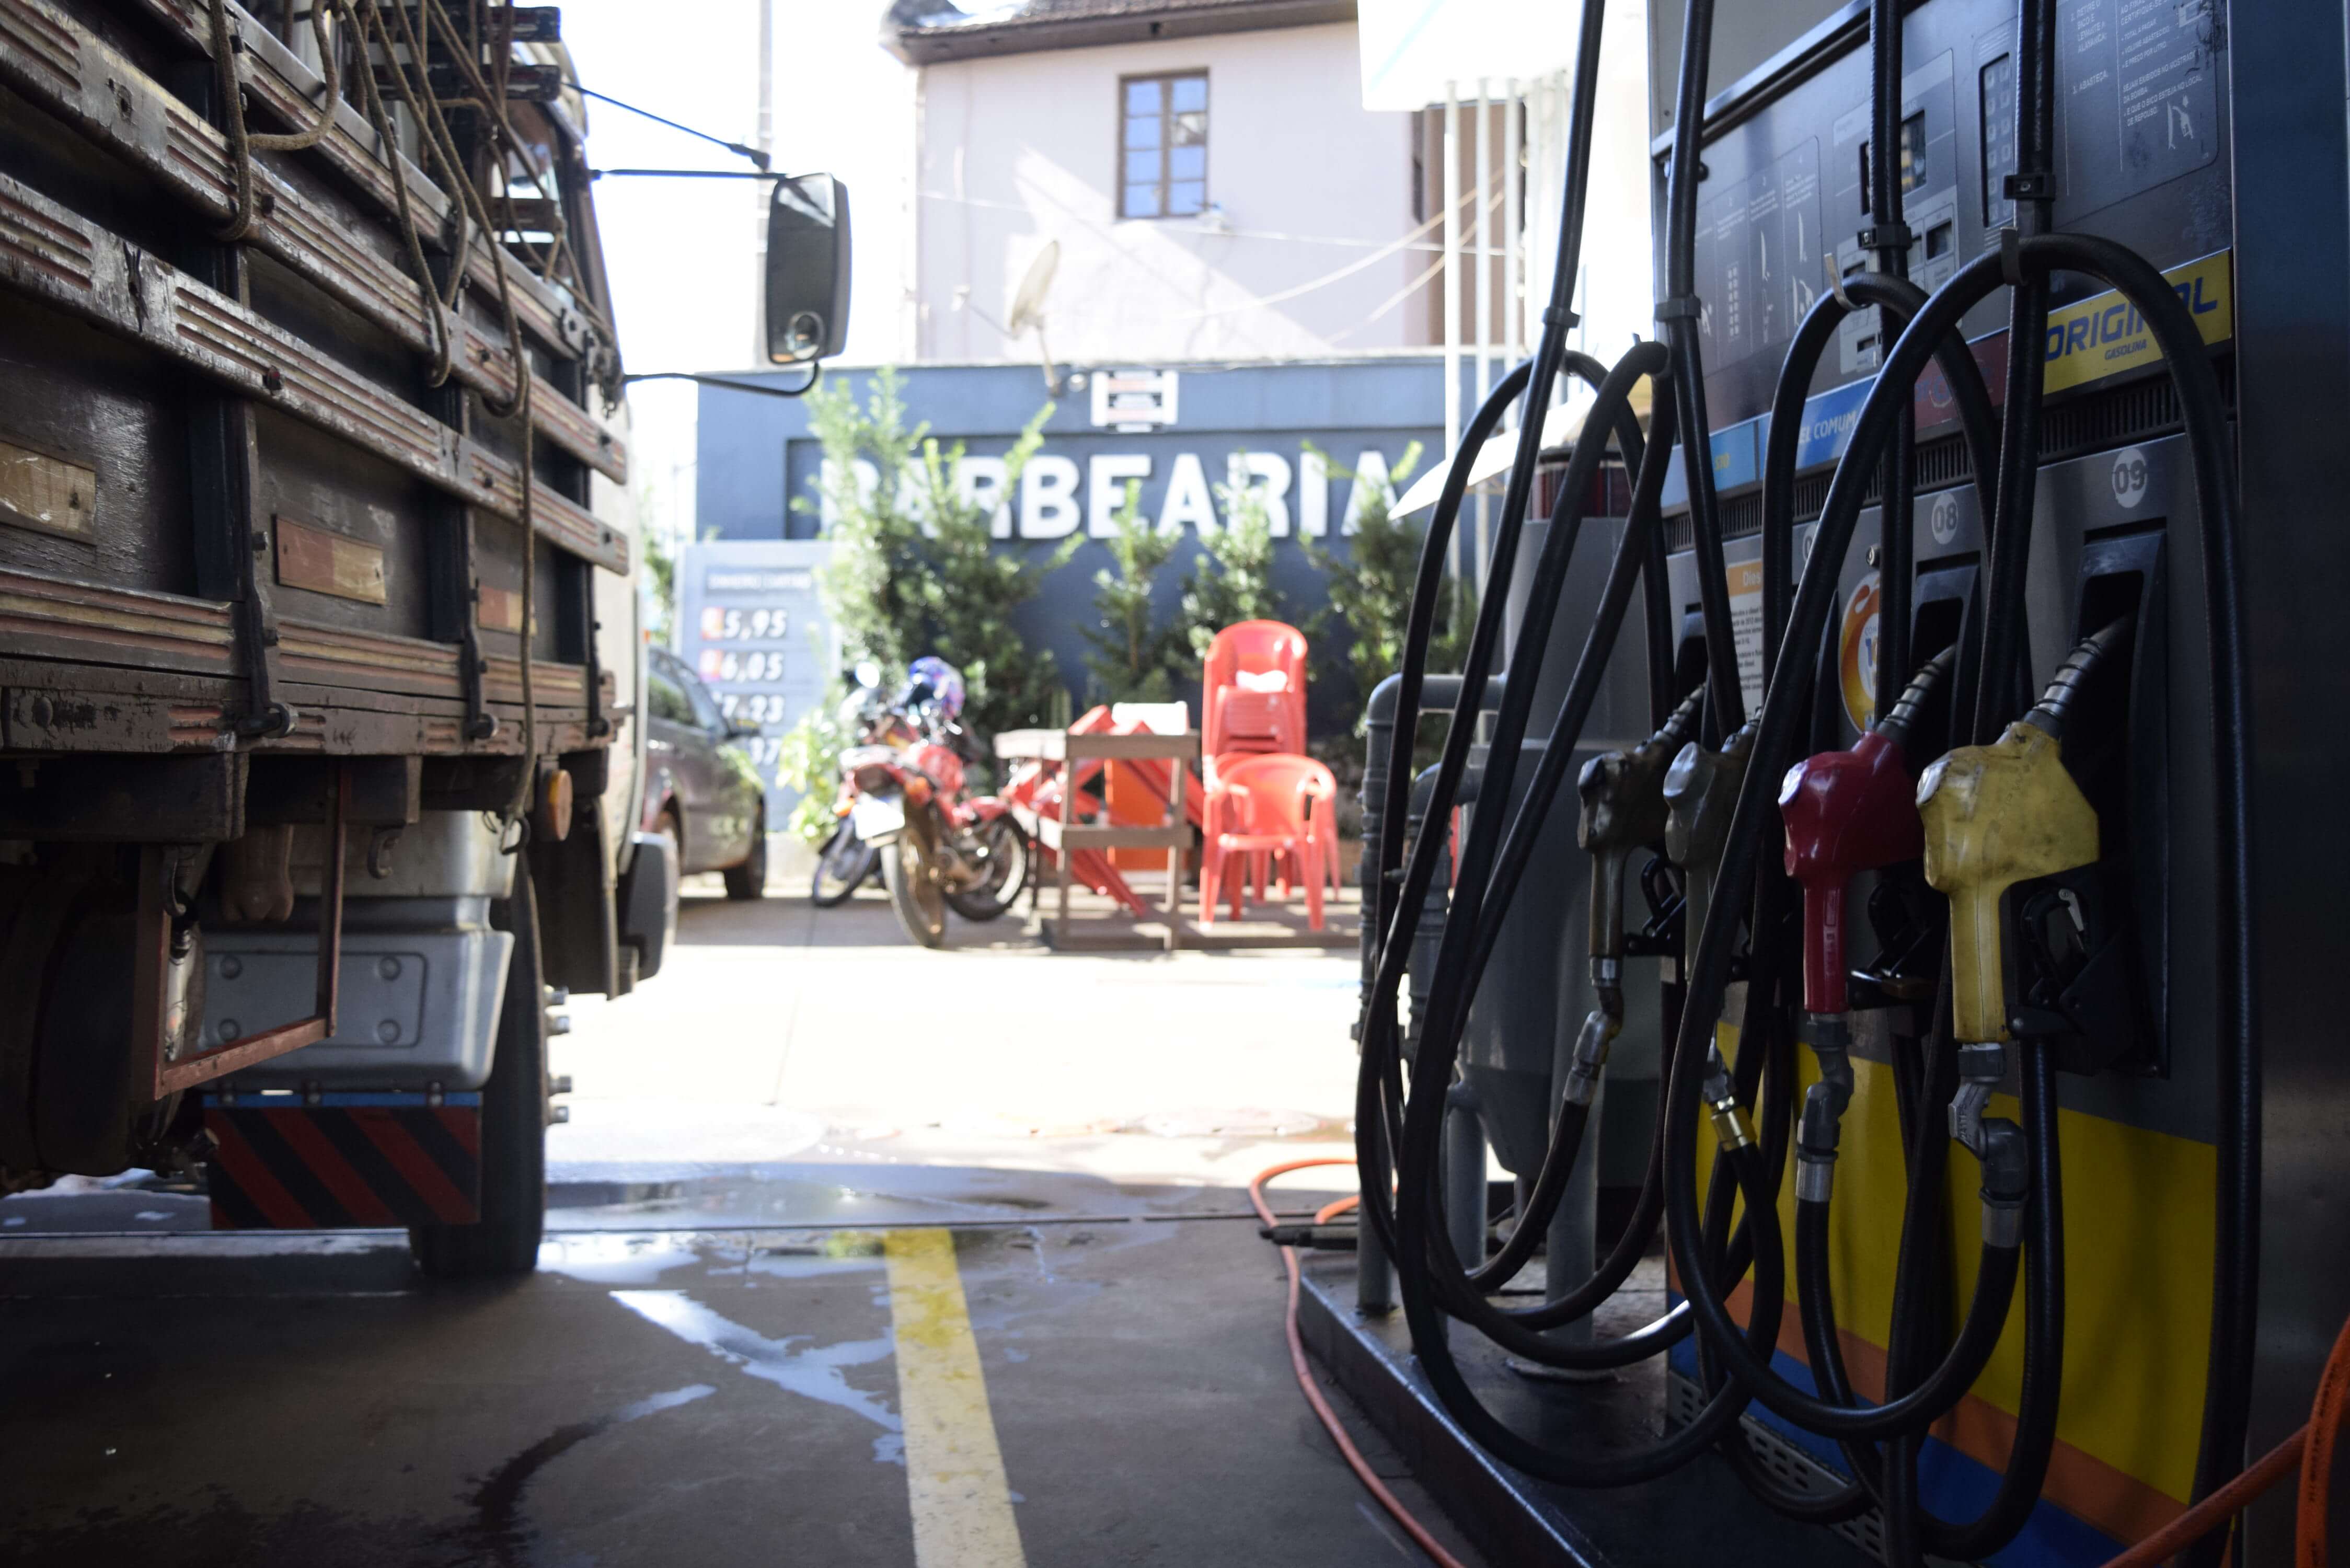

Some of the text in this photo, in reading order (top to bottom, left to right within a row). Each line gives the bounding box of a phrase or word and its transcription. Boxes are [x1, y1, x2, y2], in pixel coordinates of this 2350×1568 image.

[2114, 459, 2145, 495] 09
[1934, 504, 1957, 533] 08
[724, 609, 787, 641] 5,95
